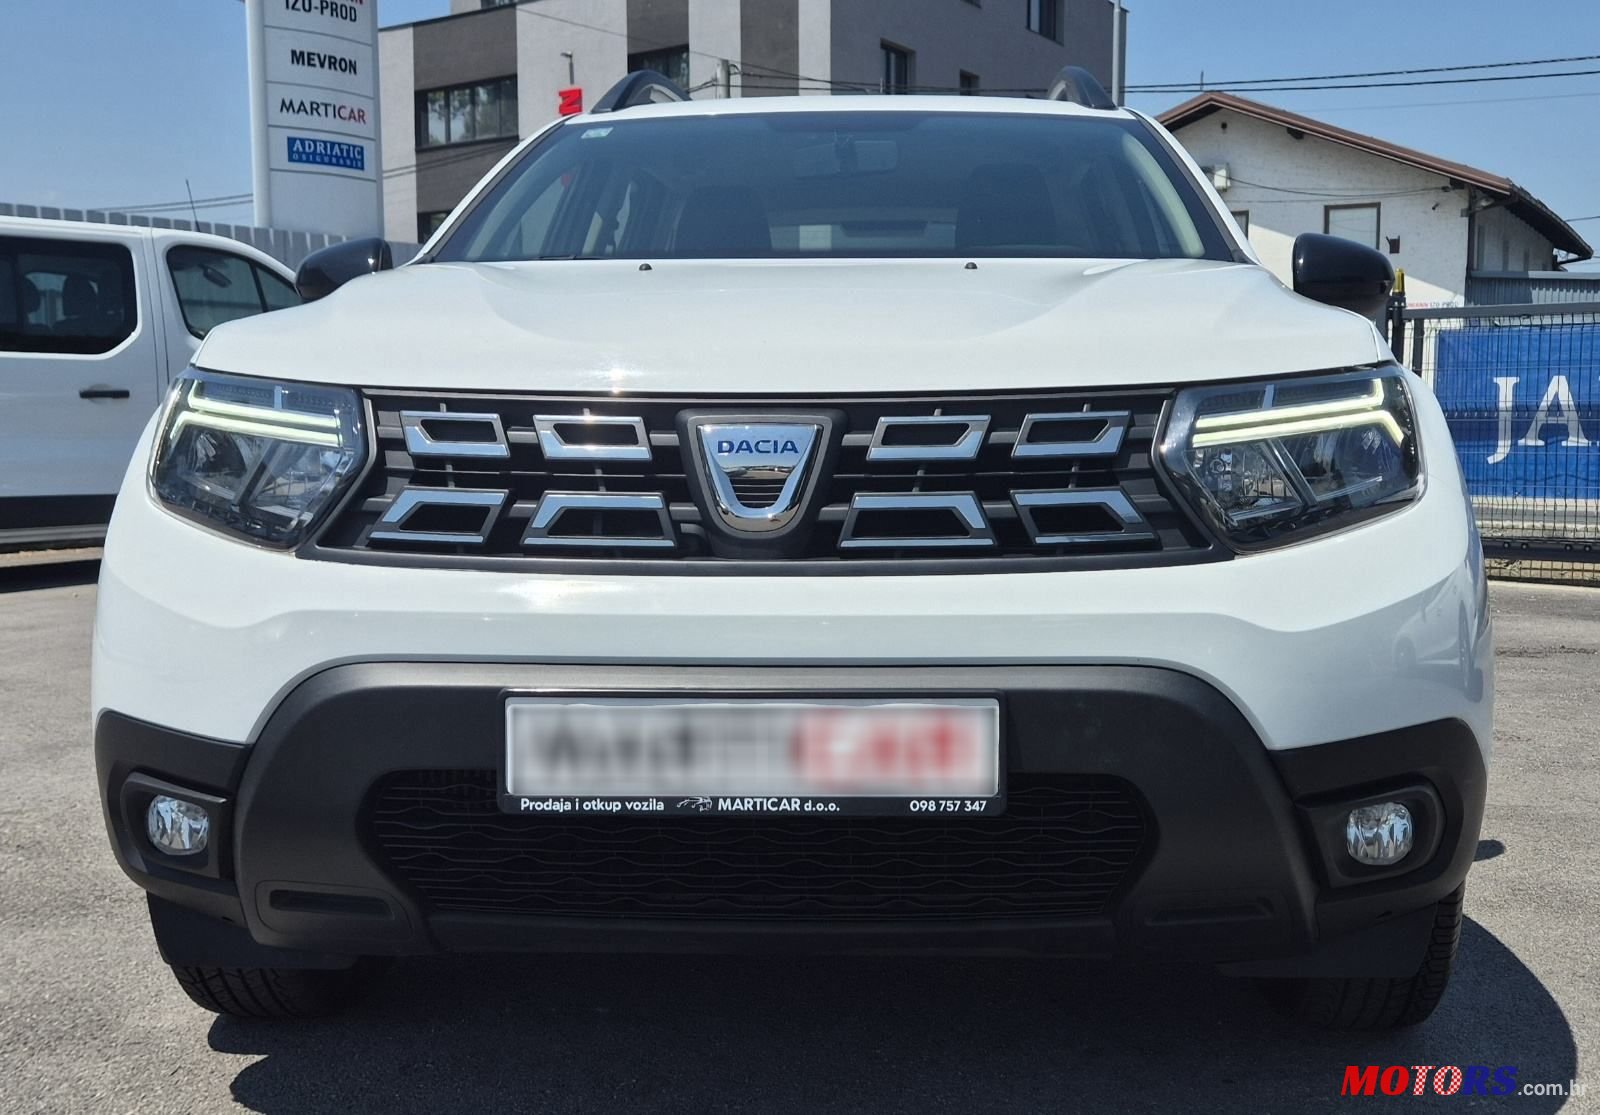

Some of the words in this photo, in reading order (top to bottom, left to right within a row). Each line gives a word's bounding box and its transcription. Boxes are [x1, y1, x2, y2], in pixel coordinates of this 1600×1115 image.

[291, 49, 357, 75] MEVRON
[279, 98, 366, 125] MARTICAR
[293, 139, 361, 159] ADRIATIC
[717, 440, 799, 454] DACIA
[520, 798, 572, 812] Prodaja
[575, 798, 580, 810] i
[582, 798, 622, 812] otkup
[625, 798, 665, 811] vozila
[718, 798, 800, 811] MARTICAR
[803, 799, 841, 811] d.o.o.
[910, 800, 936, 811] 098
[939, 800, 960, 811] 757
[964, 800, 986, 811] 347
